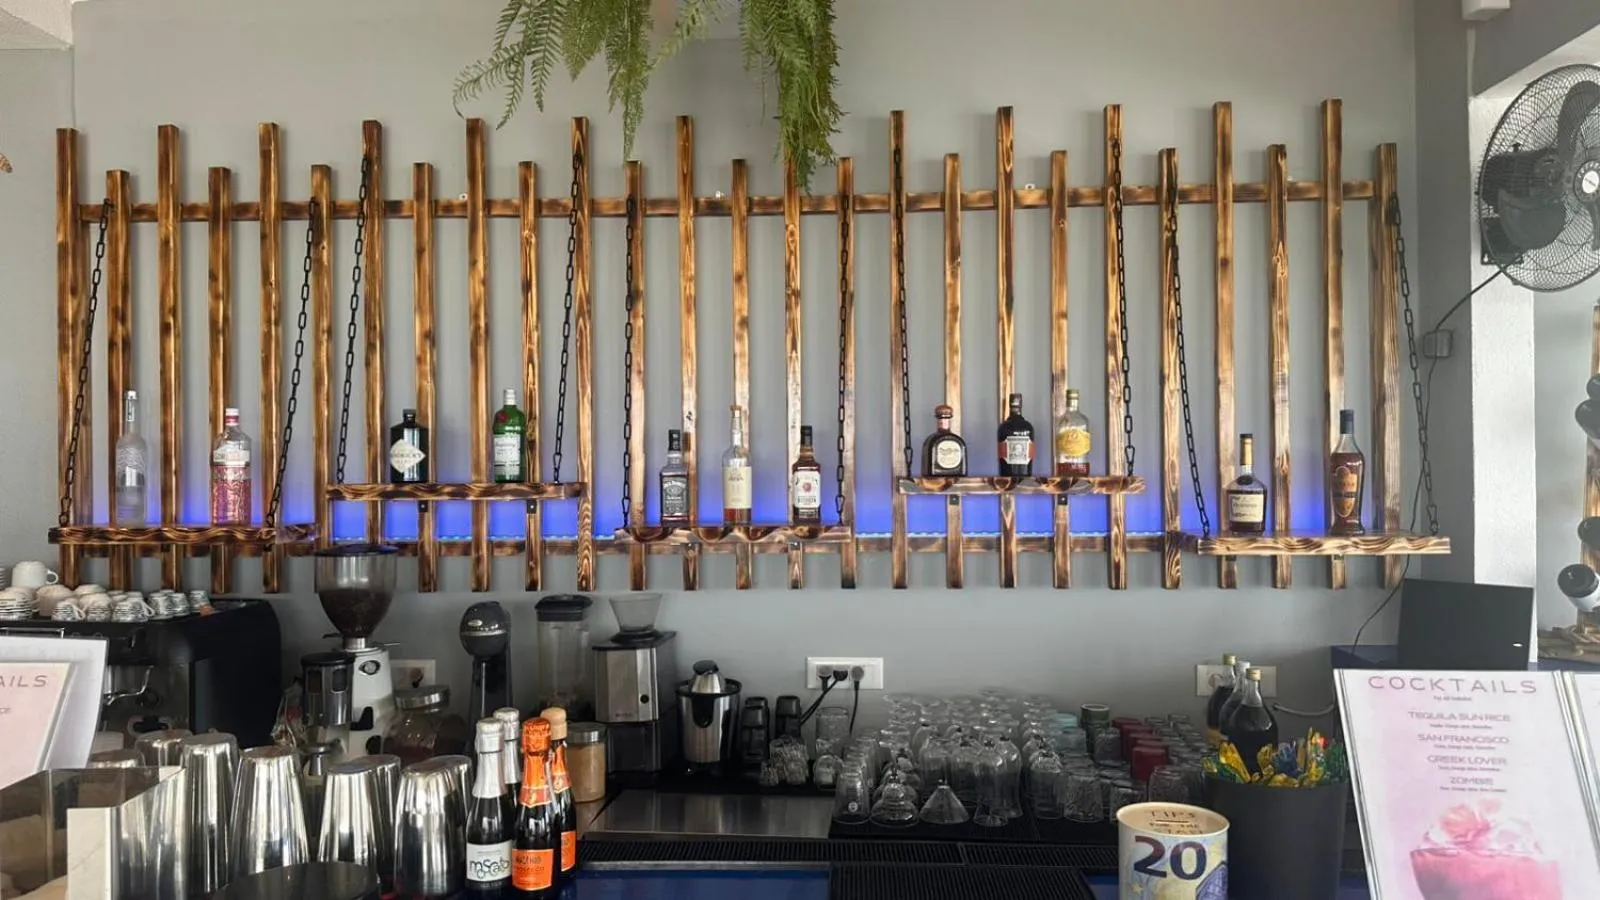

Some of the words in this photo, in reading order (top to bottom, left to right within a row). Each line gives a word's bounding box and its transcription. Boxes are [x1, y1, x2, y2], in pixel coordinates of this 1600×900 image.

[1368, 676, 1537, 694] COCKTAILS
[1408, 711, 1457, 721] TEQUILA
[1417, 733, 1442, 742] SAN
[1444, 735, 1510, 744] FRANCISCO
[1468, 756, 1507, 765] LOVER
[1450, 776, 1494, 785] ZOMBIE
[1133, 835, 1207, 880] 20
